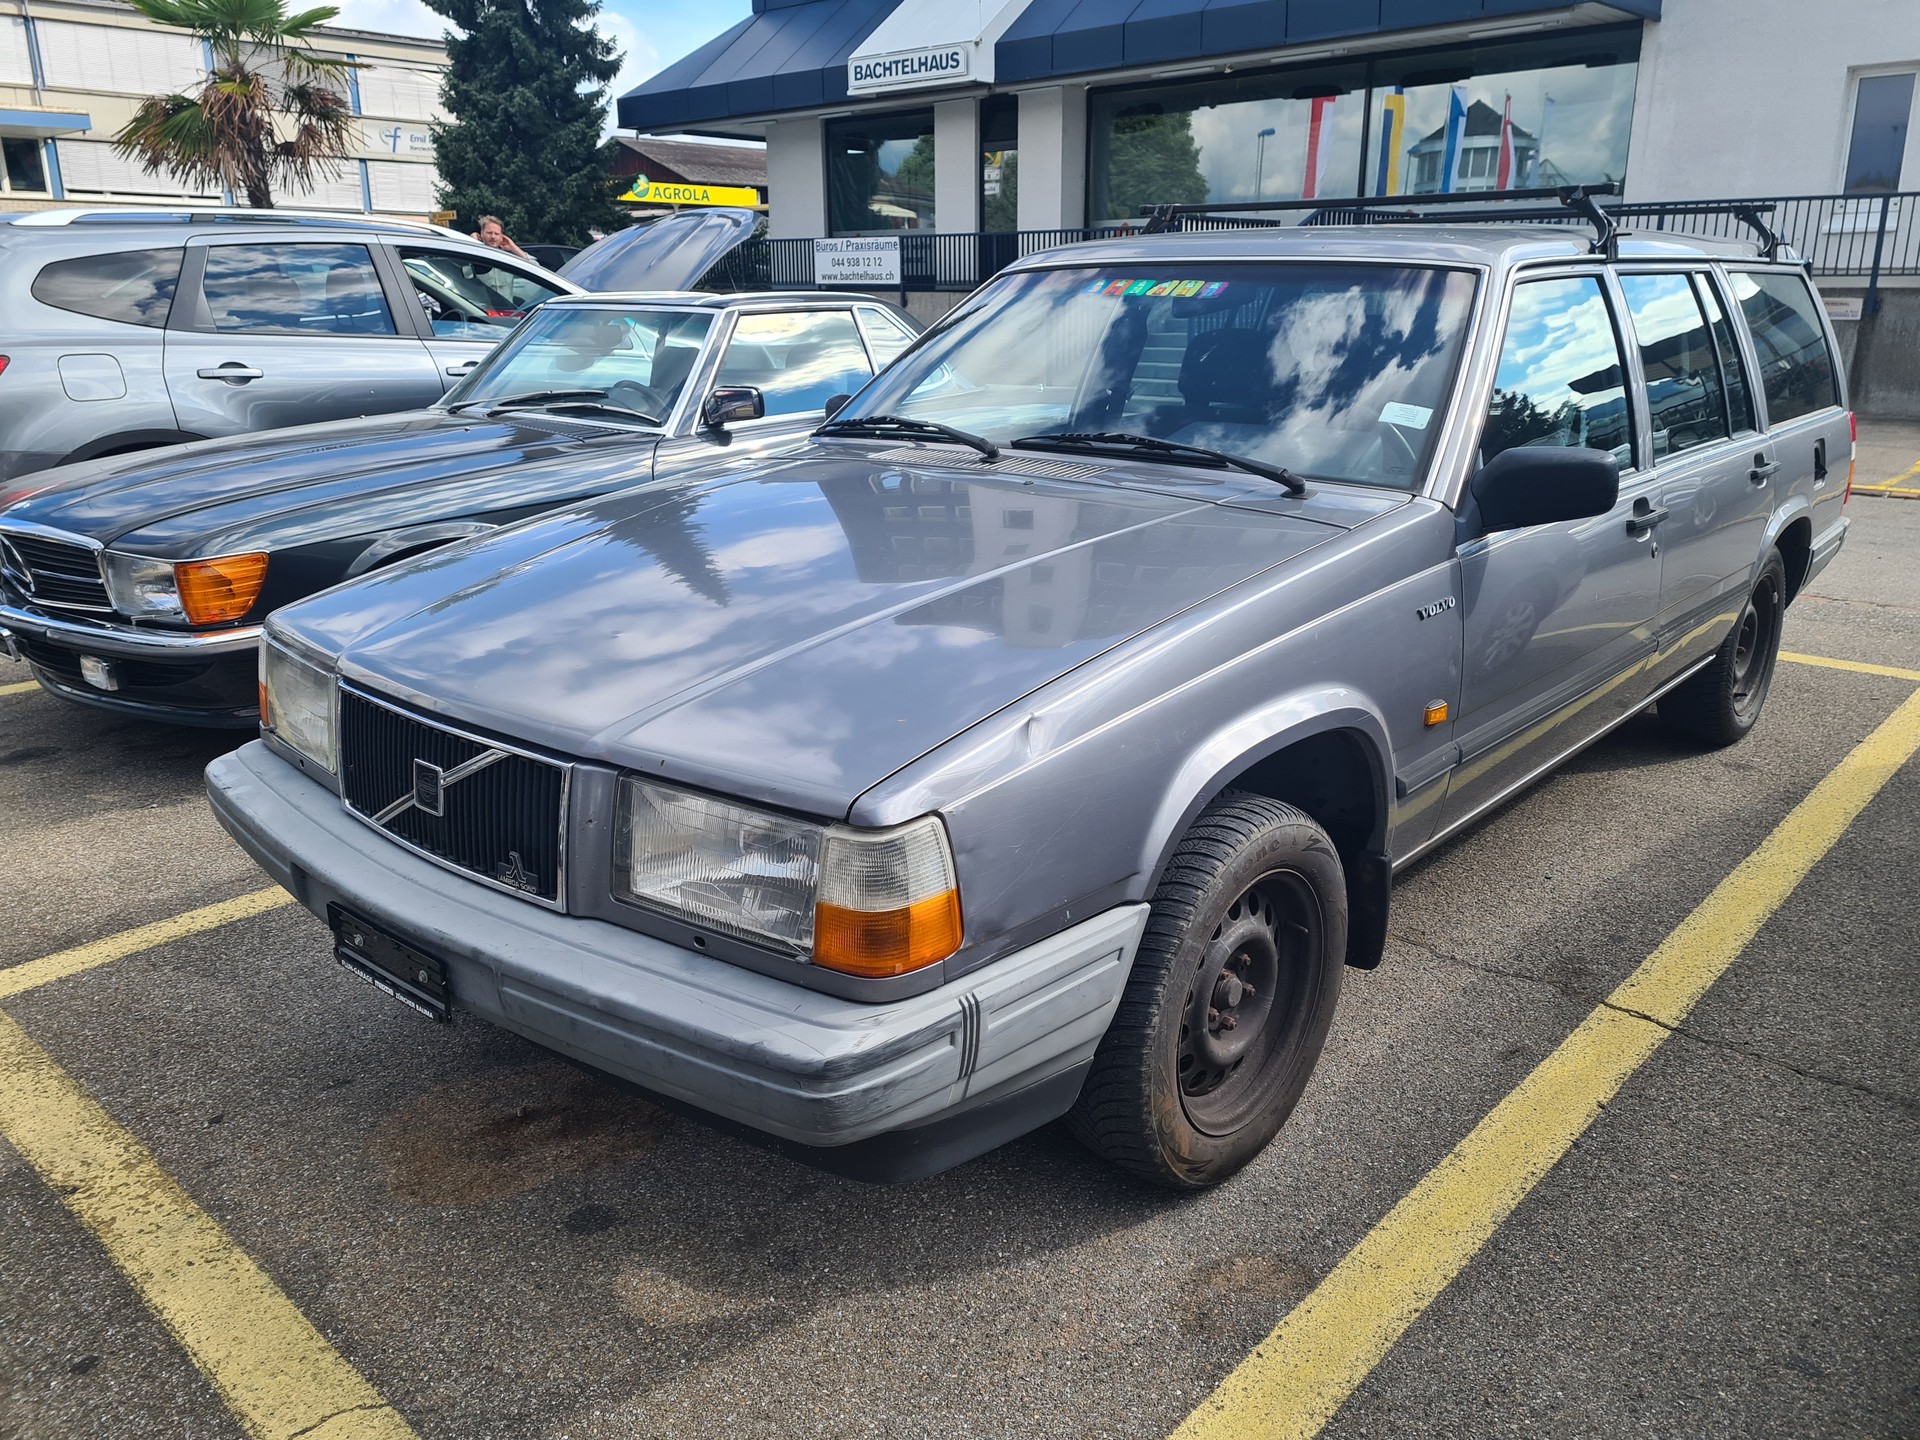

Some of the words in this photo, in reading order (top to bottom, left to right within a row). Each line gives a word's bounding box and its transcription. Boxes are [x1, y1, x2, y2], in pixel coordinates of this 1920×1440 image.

[854, 51, 961, 82] BACHTELHAUS
[409, 133, 427, 143] Emil
[653, 186, 710, 202] AGROLA
[815, 240, 838, 252] Büros
[840, 240, 844, 252] /
[845, 238, 898, 251] Praxisräume
[831, 257, 845, 267] 044
[847, 257, 860, 267] 938
[862, 257, 871, 267] 12
[873, 256, 882, 267] 12
[821, 270, 895, 281] www.bachtelhaus.ch
[1417, 596, 1456, 621] VOLVO
